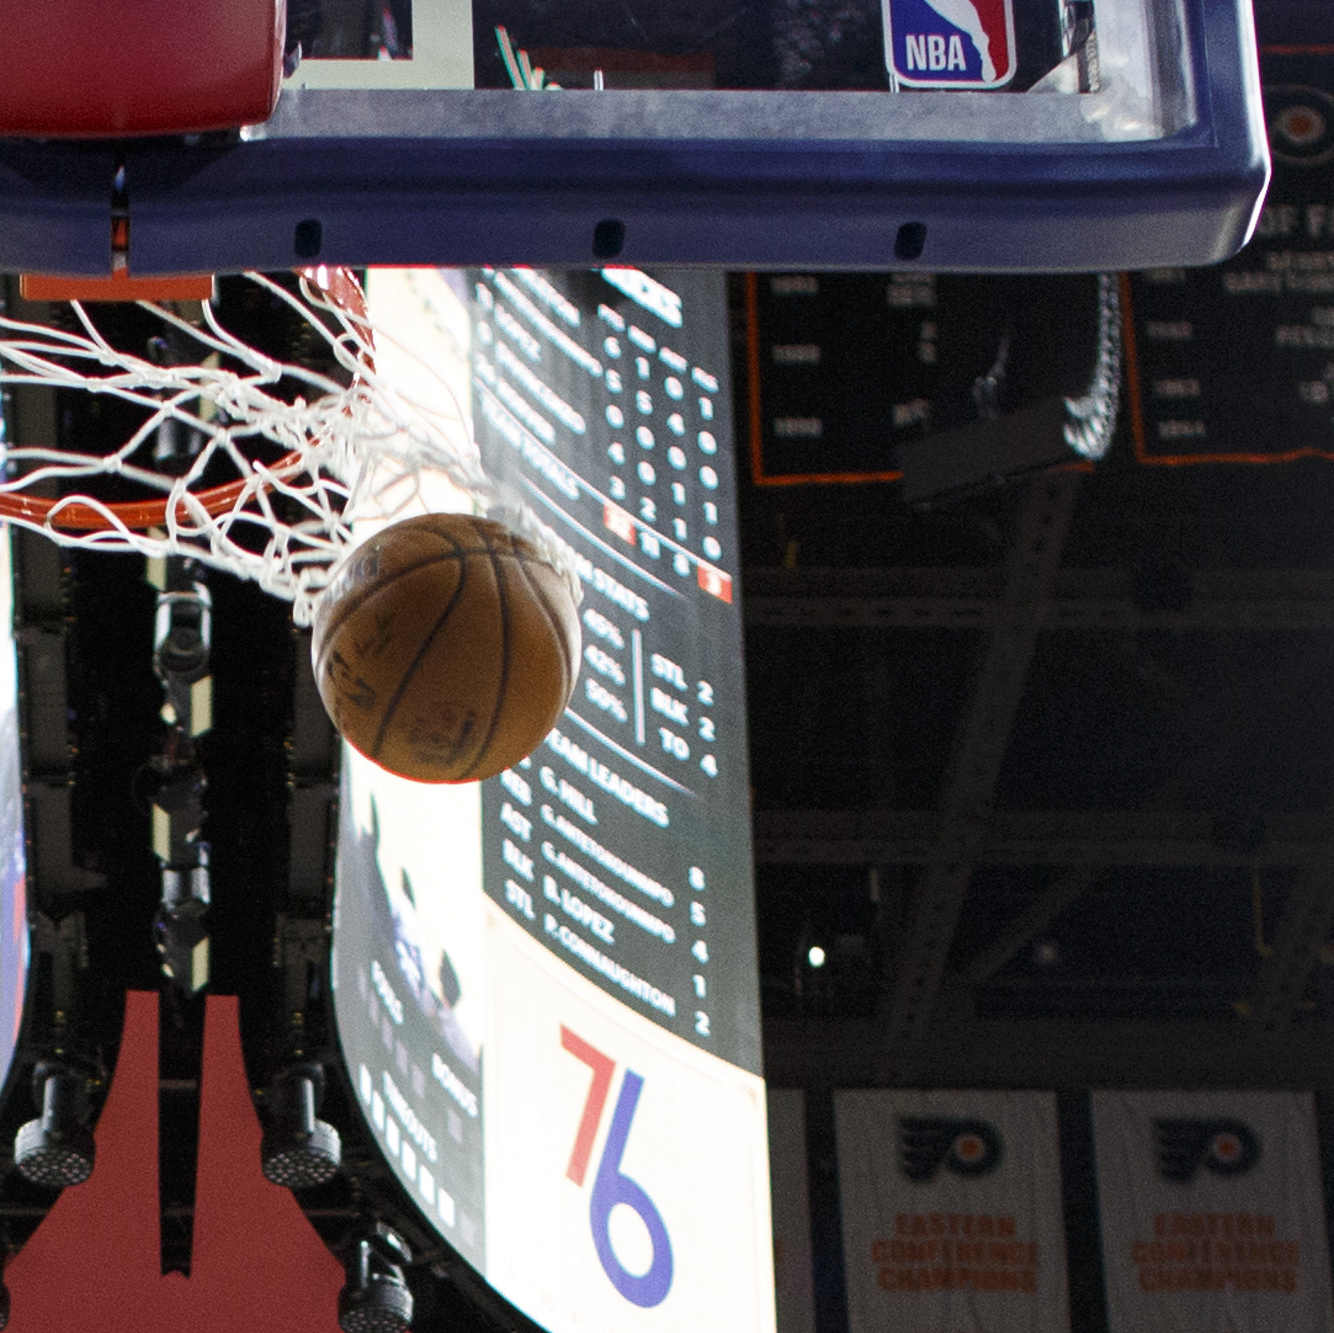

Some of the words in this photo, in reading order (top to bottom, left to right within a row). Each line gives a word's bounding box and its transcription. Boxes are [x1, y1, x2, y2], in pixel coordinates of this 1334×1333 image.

[905, 34, 967, 72] NBA
[593, 568, 649, 622] STATS
[650, 653, 688, 692] STL
[697, 680, 714, 706] 2
[650, 687, 689, 727] BLK
[698, 717, 715, 742] 2
[546, 728, 589, 776] EAM
[587, 756, 670, 828] LEADERS
[658, 727, 690, 761] TO
[700, 754, 718, 778] 4
[505, 879, 536, 921] STL
[695, 1010, 711, 1037] 2
[561, 888, 615, 945] LOPEZ
[692, 974, 706, 998] 1
[691, 940, 709, 964] 4
[560, 1023, 674, 1308] 76
